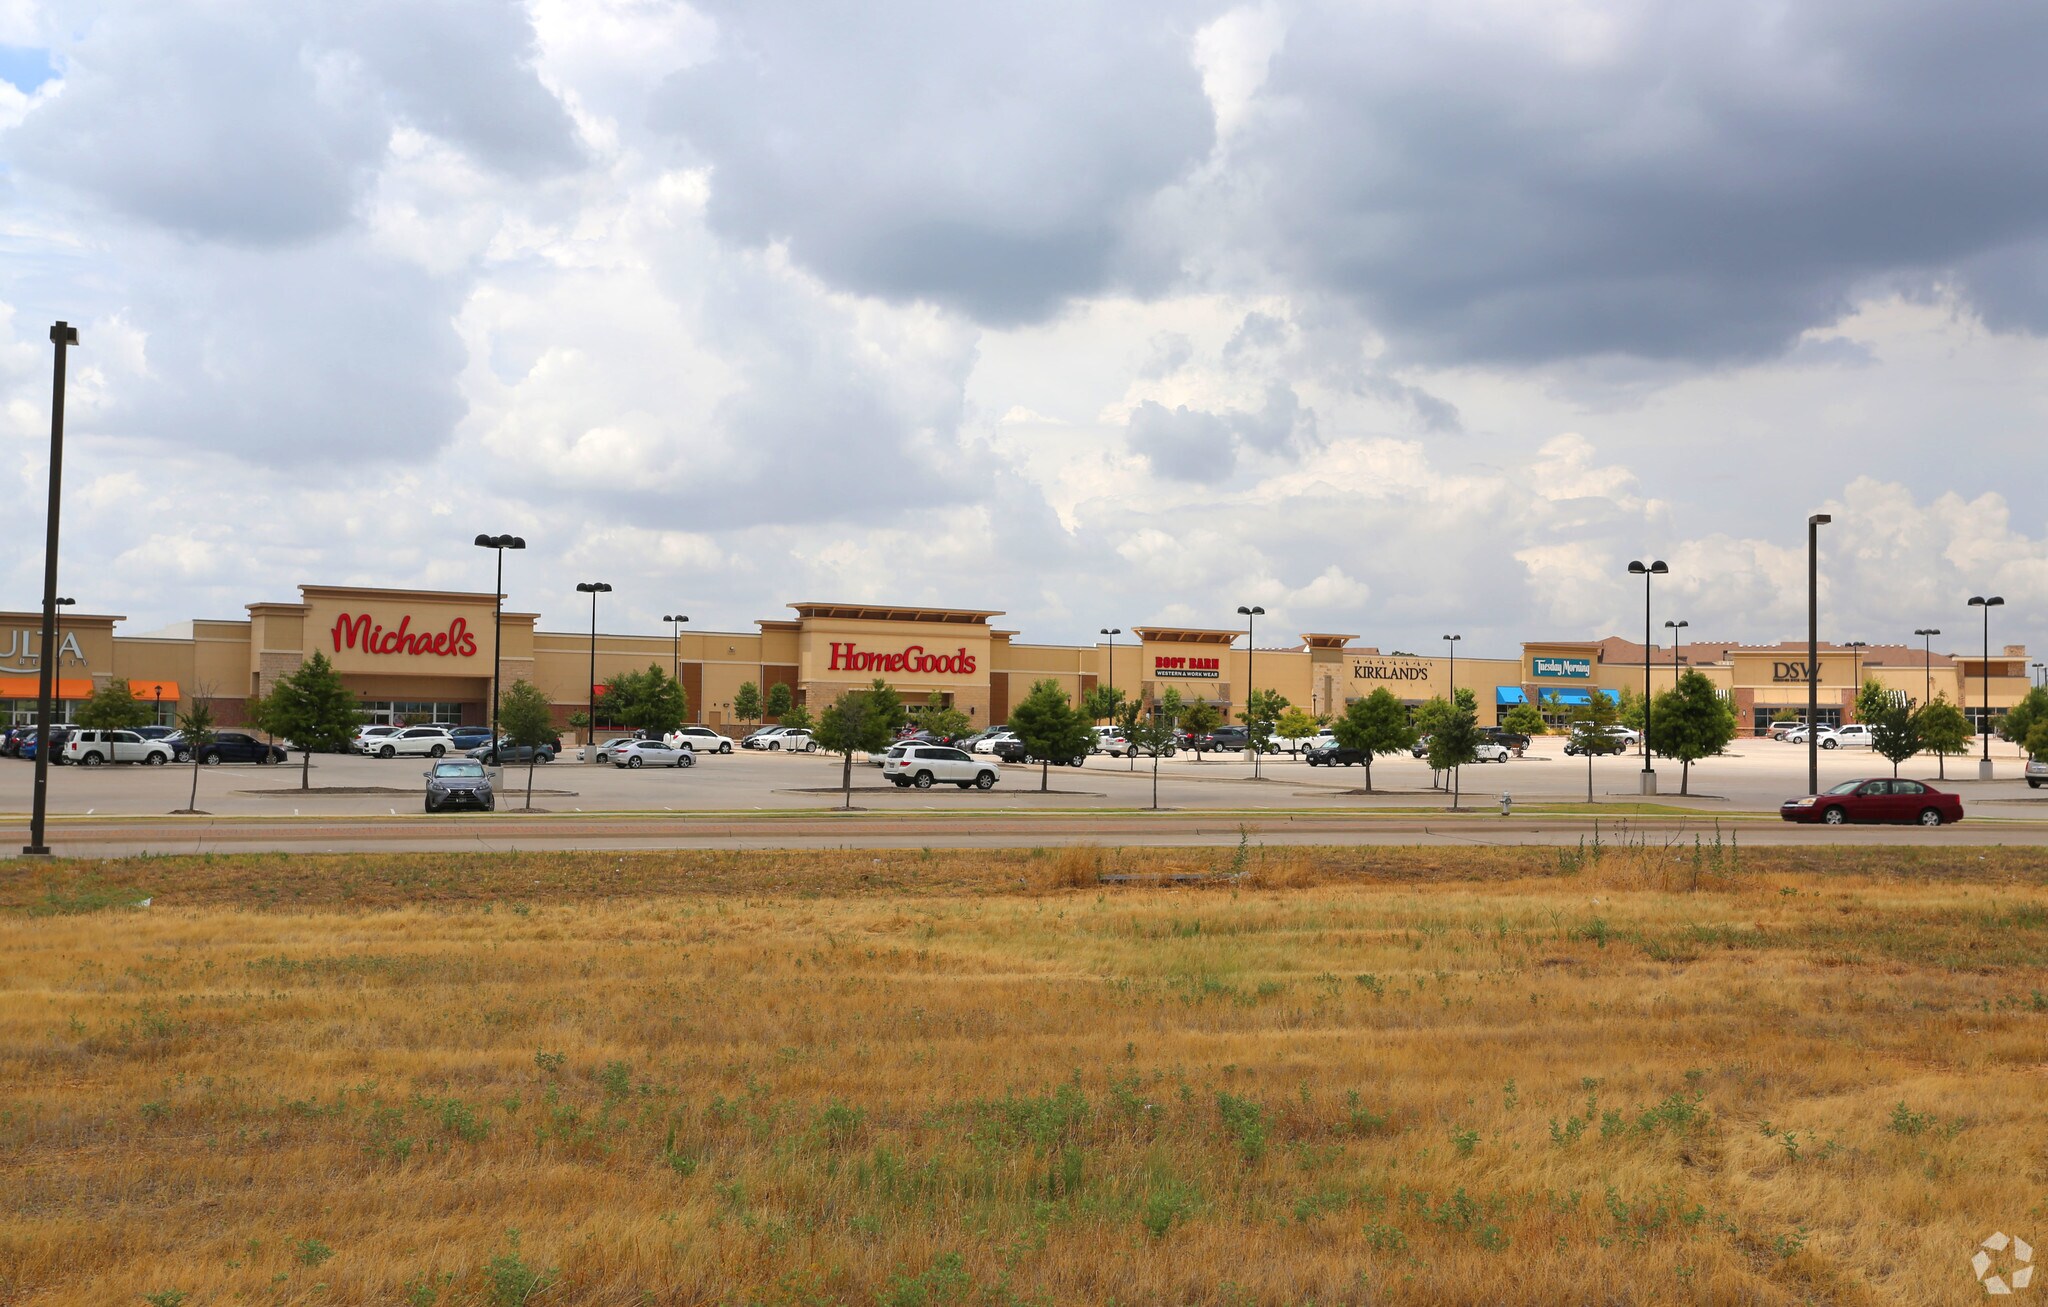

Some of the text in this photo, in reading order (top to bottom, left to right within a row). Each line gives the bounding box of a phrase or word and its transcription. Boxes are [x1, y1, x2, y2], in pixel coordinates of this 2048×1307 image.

[331, 613, 477, 657] Michaels
[827, 642, 977, 674] HomeGoods
[1155, 656, 1219, 670] BOOT BARN
[1354, 665, 1428, 681] KIRKLAND'S
[1535, 659, 1590, 677] Tuesday Morning
[1773, 662, 1823, 679] DSW
